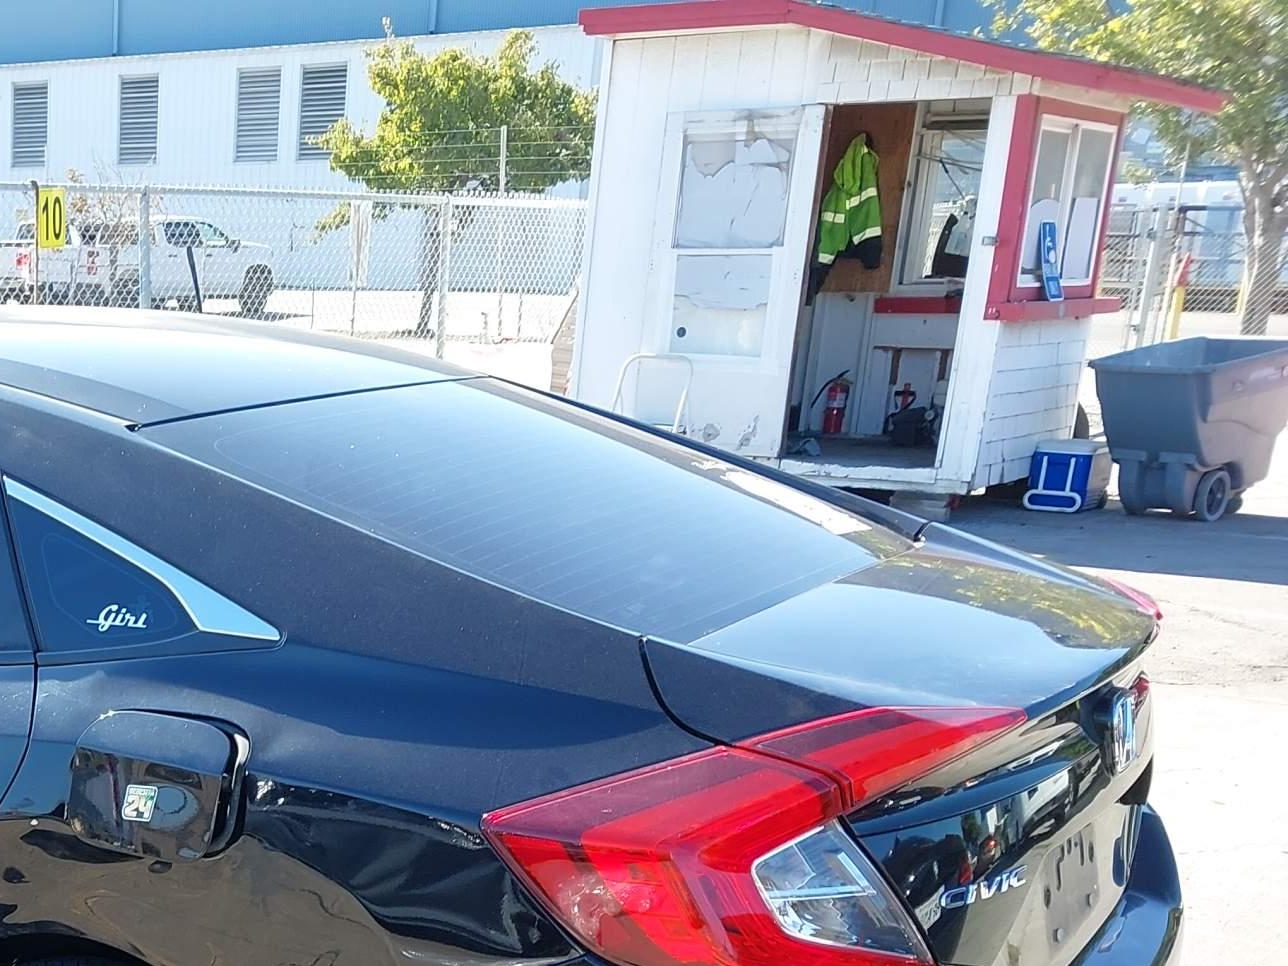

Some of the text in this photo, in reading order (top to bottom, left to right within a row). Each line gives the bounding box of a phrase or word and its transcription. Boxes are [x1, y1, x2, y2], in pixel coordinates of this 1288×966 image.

[42, 196, 62, 241] 10
[86, 604, 148, 632] Girl
[124, 795, 153, 819] 24
[940, 864, 1028, 909] CIVIC
